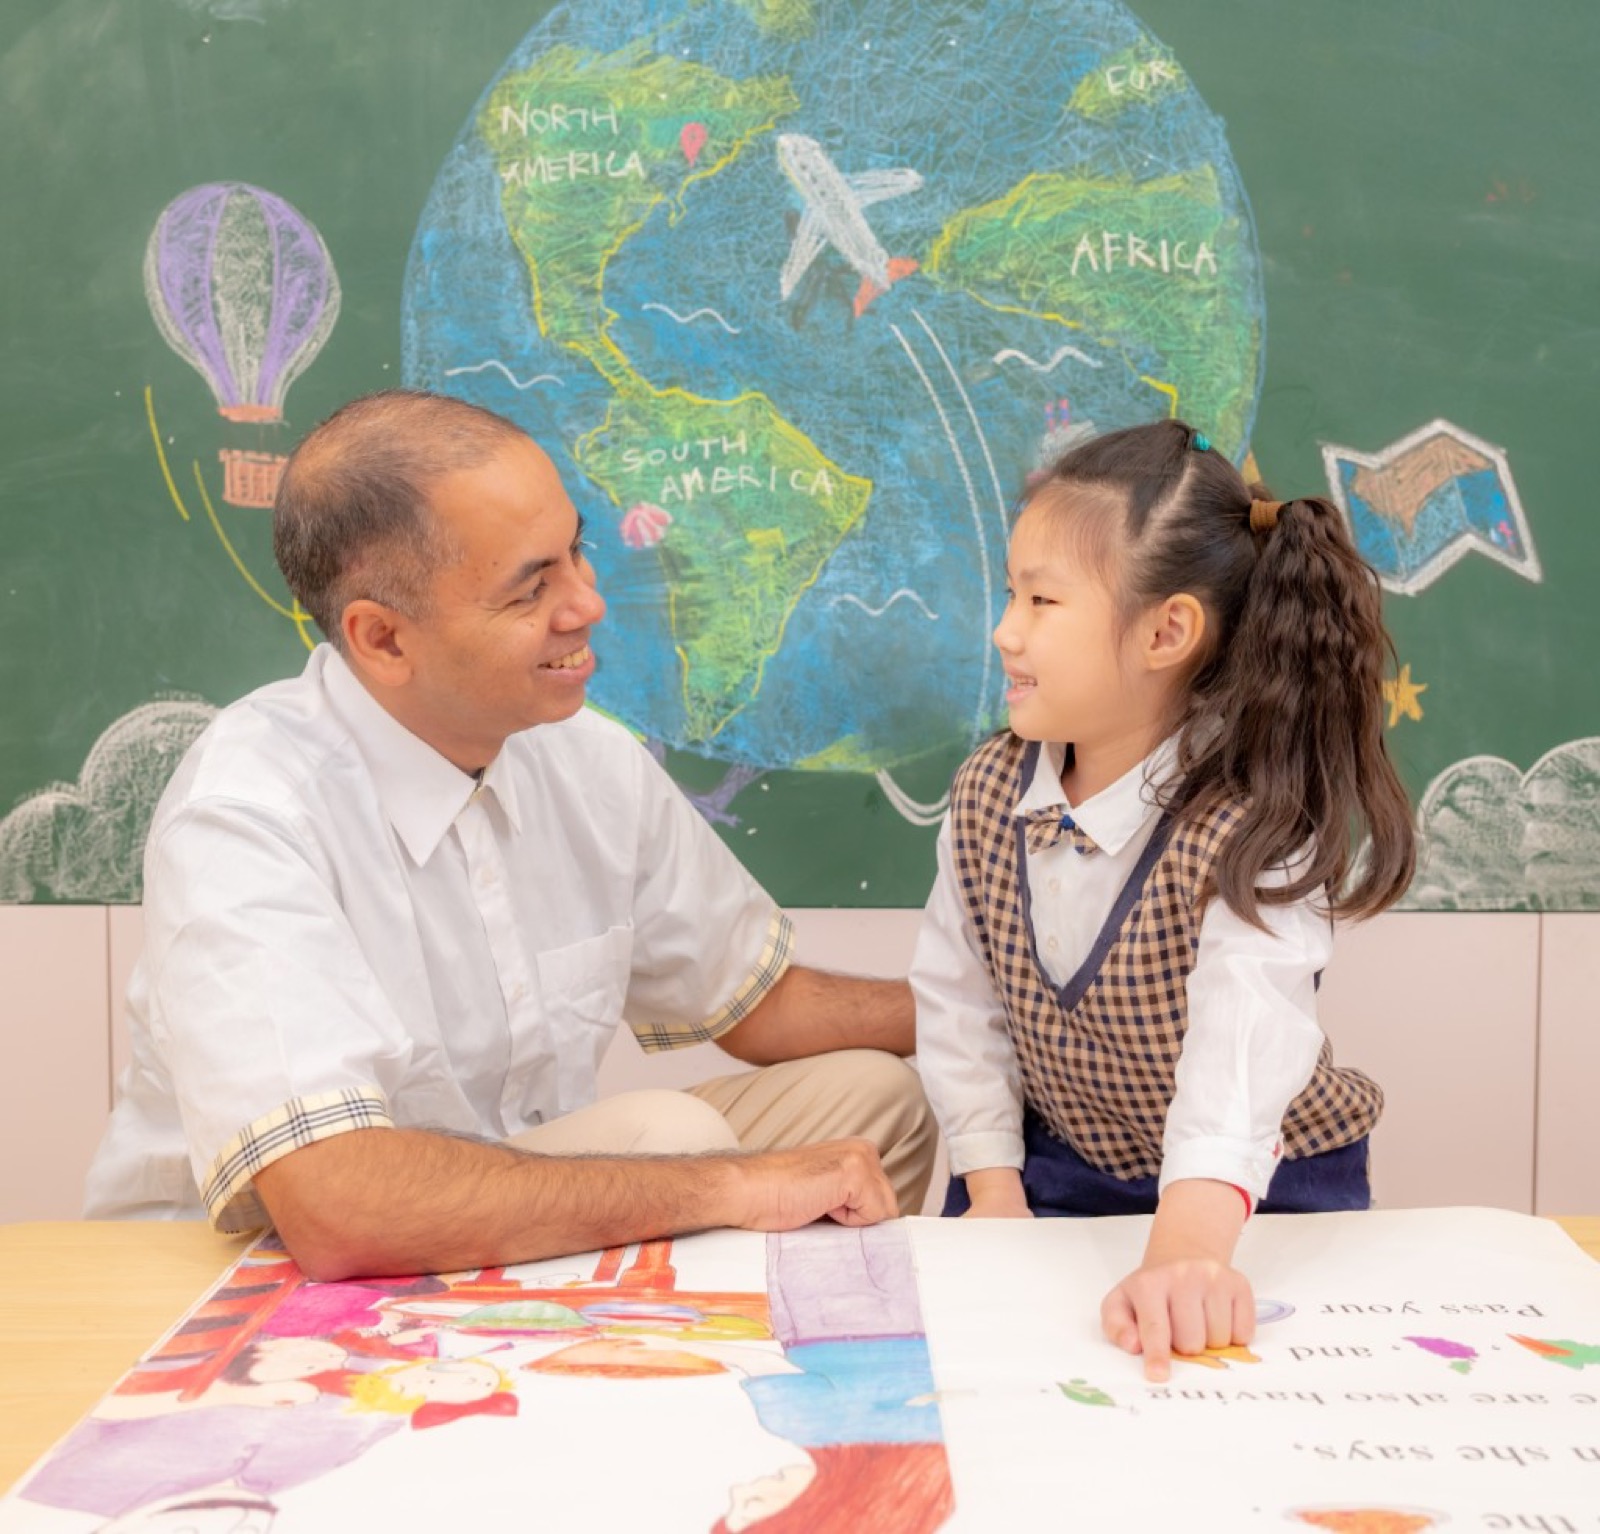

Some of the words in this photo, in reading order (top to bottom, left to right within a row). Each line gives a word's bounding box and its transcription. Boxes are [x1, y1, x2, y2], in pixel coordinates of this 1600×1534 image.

[501, 102, 618, 136] NORTH
[501, 151, 645, 187] AMERICA
[1071, 229, 1218, 276] AFRICA
[622, 429, 749, 474] SOUTH
[660, 466, 834, 504] AMERICA
[1320, 1300, 1423, 1316] your
[1440, 1302, 1547, 1319] Pass
[1288, 1345, 1373, 1361] and
[1146, 1387, 1326, 1406] having
[1345, 1391, 1449, 1406] also
[1469, 1392, 1549, 1404] are
[1459, 1446, 1550, 1467] she
[1480, 1512, 1577, 1534] the
